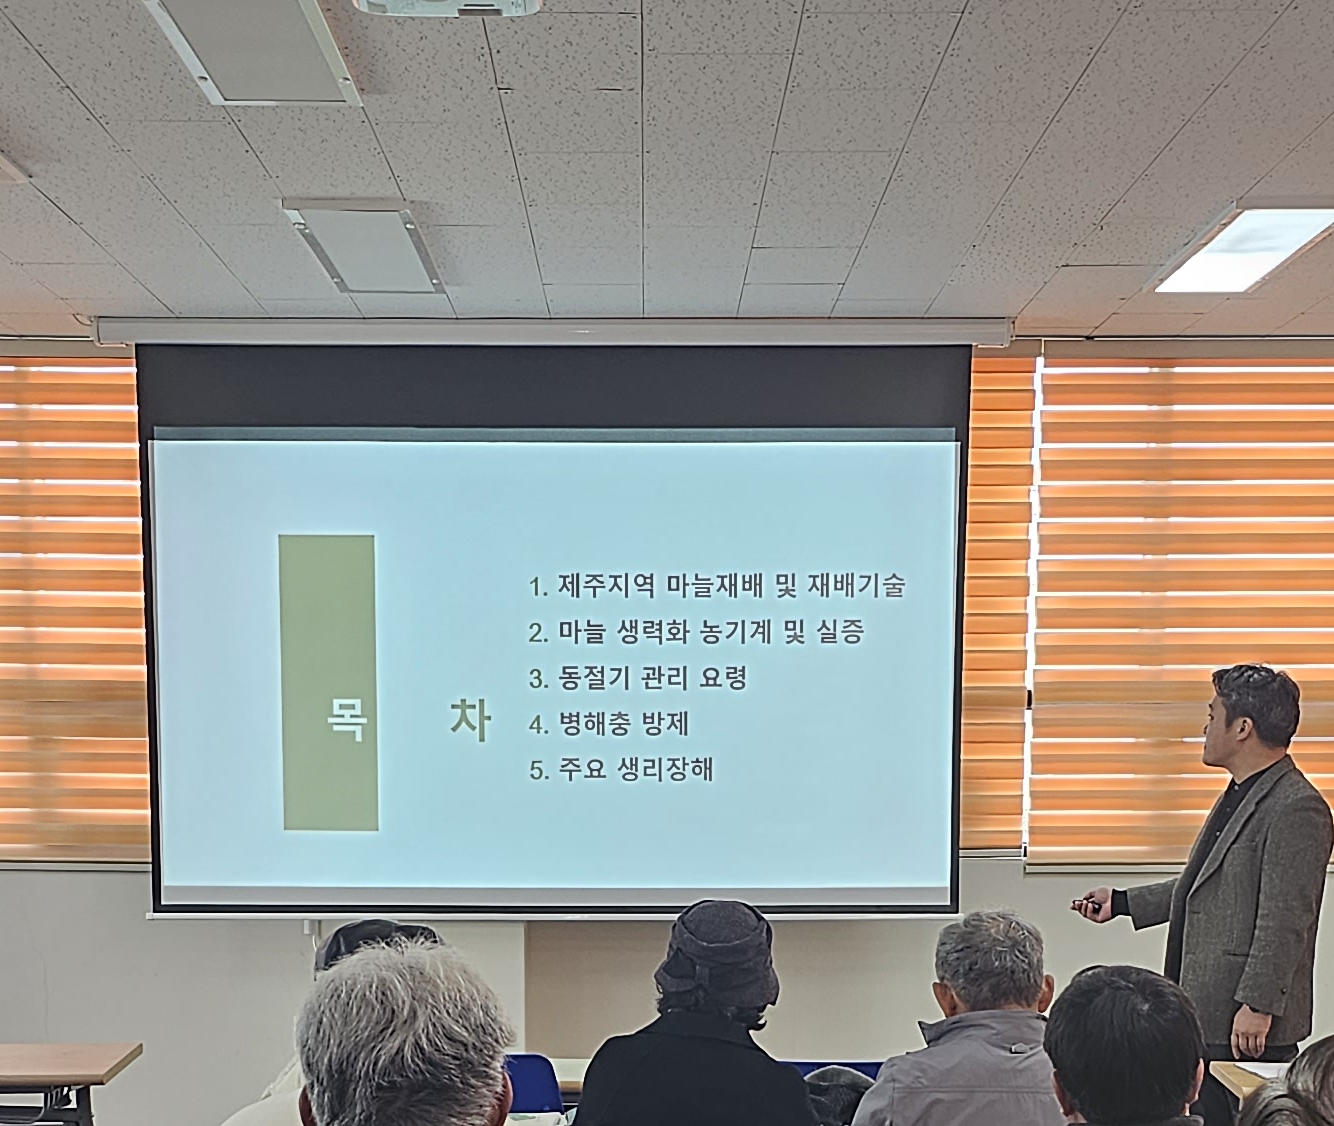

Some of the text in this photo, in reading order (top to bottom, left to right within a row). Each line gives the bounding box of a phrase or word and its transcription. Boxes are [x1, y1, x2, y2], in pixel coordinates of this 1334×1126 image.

[529, 573, 906, 599] 1. 제주지역 마늘재배 및 재배기술
[529, 619, 864, 645] 2. 마늘 생력화 농기계 및 실증
[529, 665, 747, 691] 3. 동절기 관리 요령
[327, 698, 367, 743] 목
[449, 697, 492, 743] 차
[529, 711, 689, 737] 4. 병해충 방제
[529, 756, 713, 783] 5. 주요 생리장해
